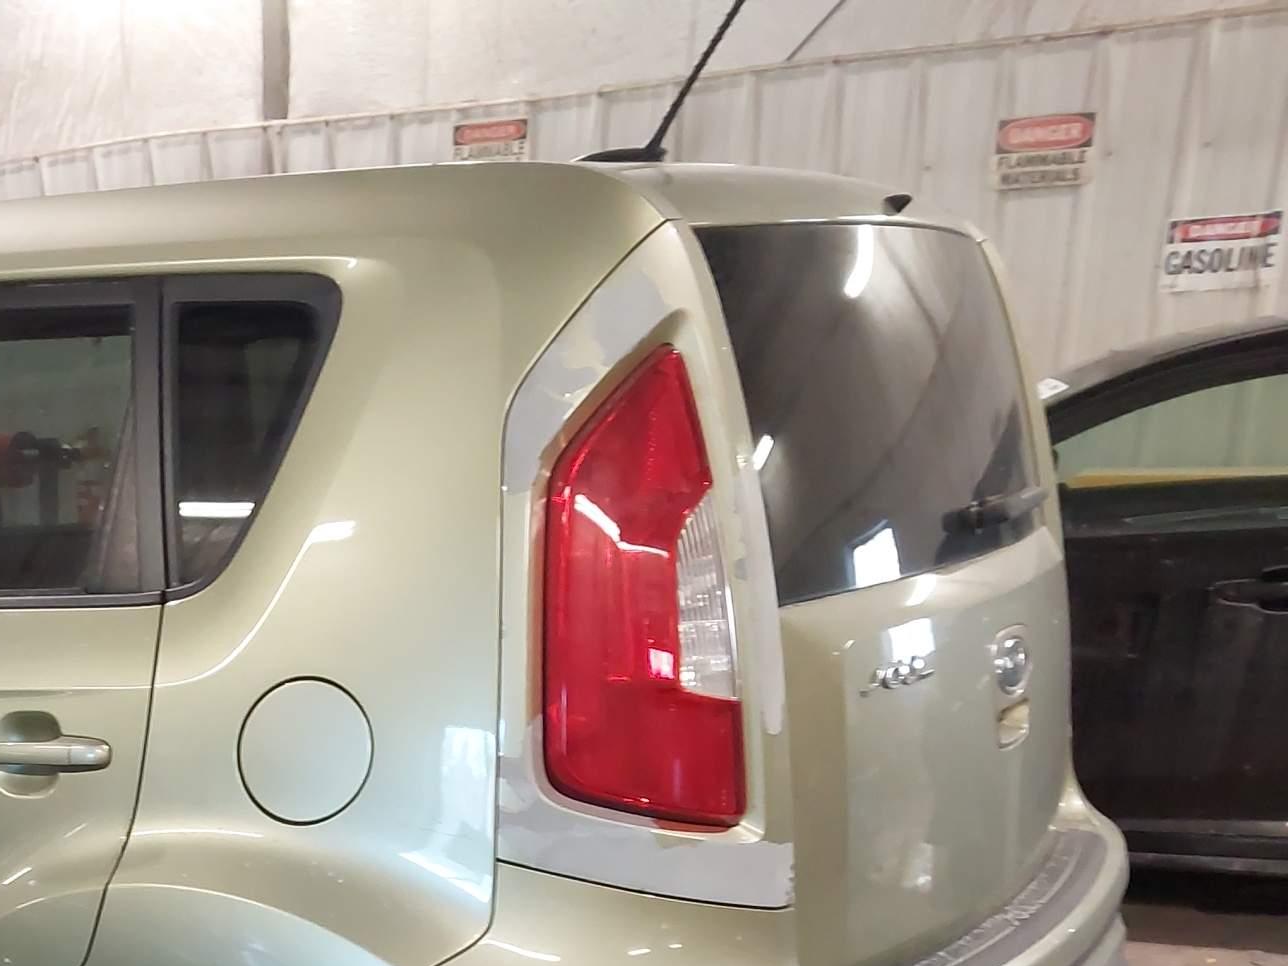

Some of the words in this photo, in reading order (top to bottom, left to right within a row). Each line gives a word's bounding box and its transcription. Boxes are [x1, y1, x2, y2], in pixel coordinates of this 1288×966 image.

[1006, 121, 1082, 144] DANGER
[997, 150, 1086, 170] FLAMMABLE
[1000, 167, 1080, 186] MATERIALS
[1164, 242, 1278, 275] GASOLINE
